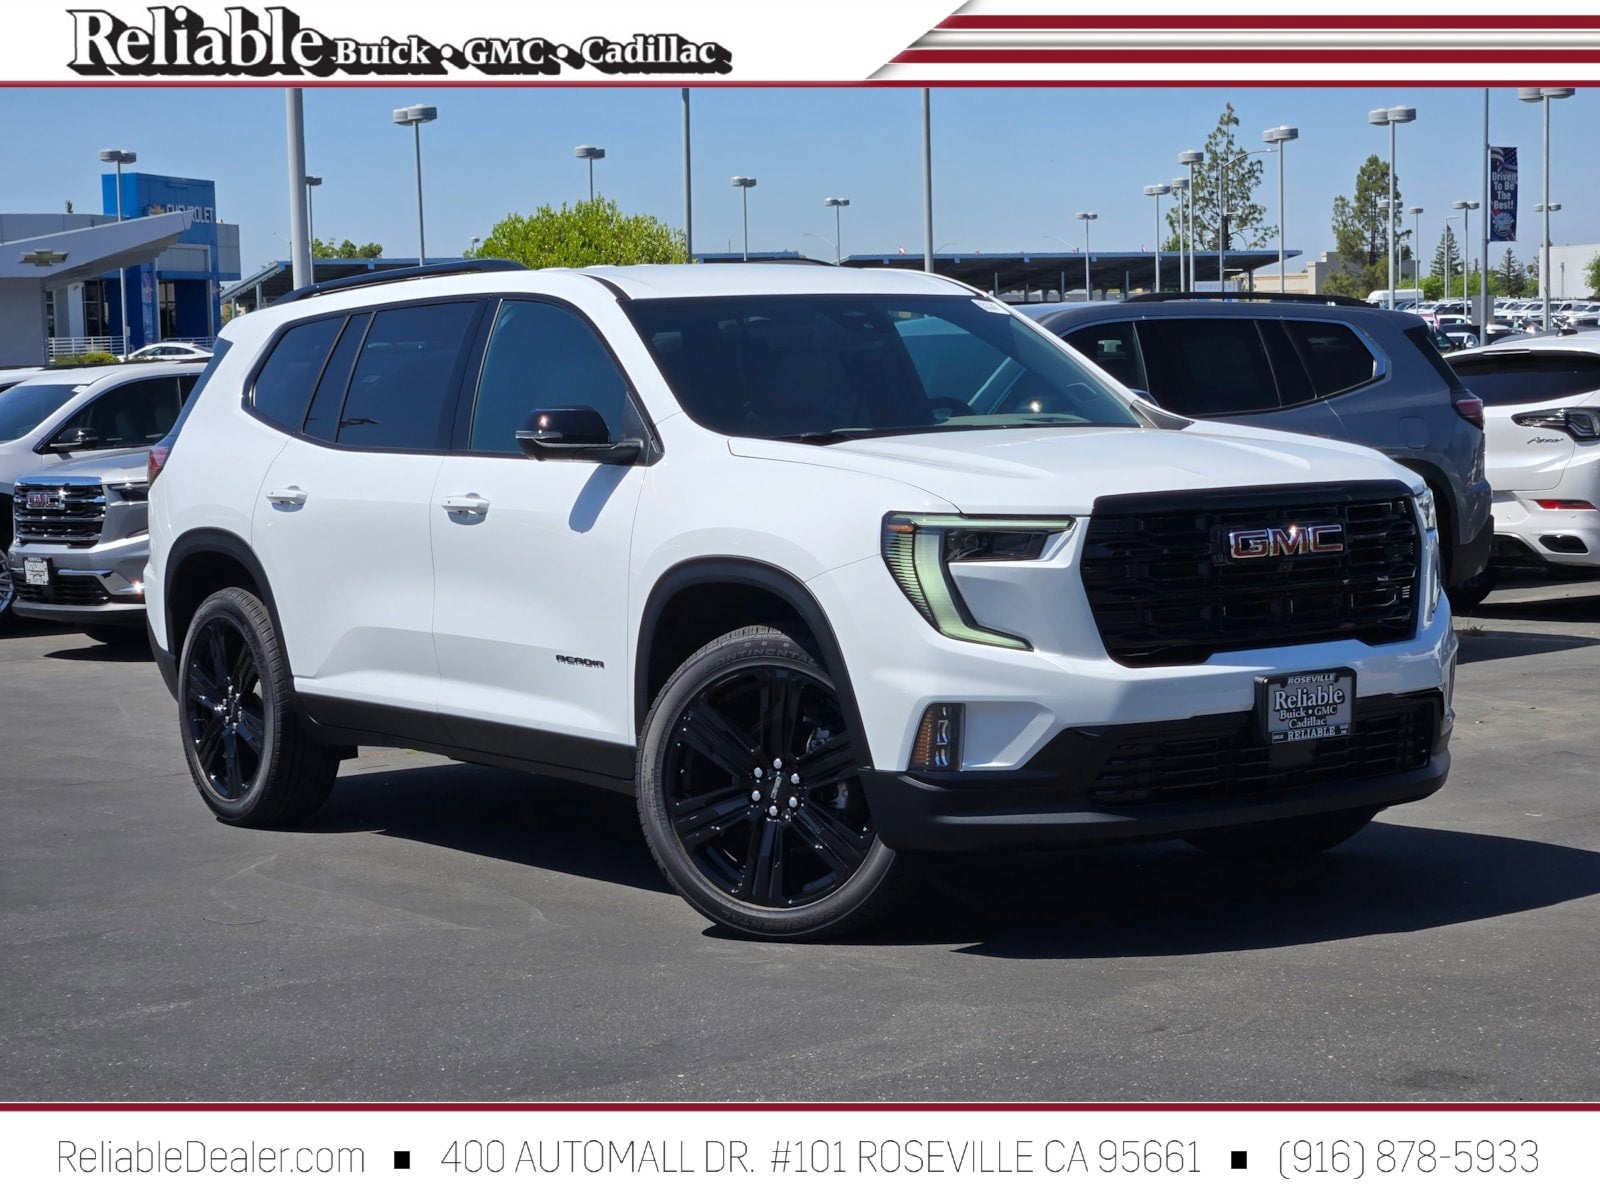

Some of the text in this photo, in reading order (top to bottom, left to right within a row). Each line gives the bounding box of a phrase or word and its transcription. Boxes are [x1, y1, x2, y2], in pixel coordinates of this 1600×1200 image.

[1492, 171, 1516, 181] Driven
[1494, 181, 1514, 190] To Be
[1497, 191, 1511, 200] The
[1493, 200, 1513, 209] Best!
[1229, 524, 1344, 559] GMC
[555, 654, 605, 670] ACADIA
[1287, 673, 1335, 685] ROSEVILLE
[1273, 684, 1344, 711] Reliable
[1280, 704, 1337, 719] Buick GMC
[1288, 716, 1326, 729] Cadillac
[1287, 726, 1336, 741] RELIABLE
